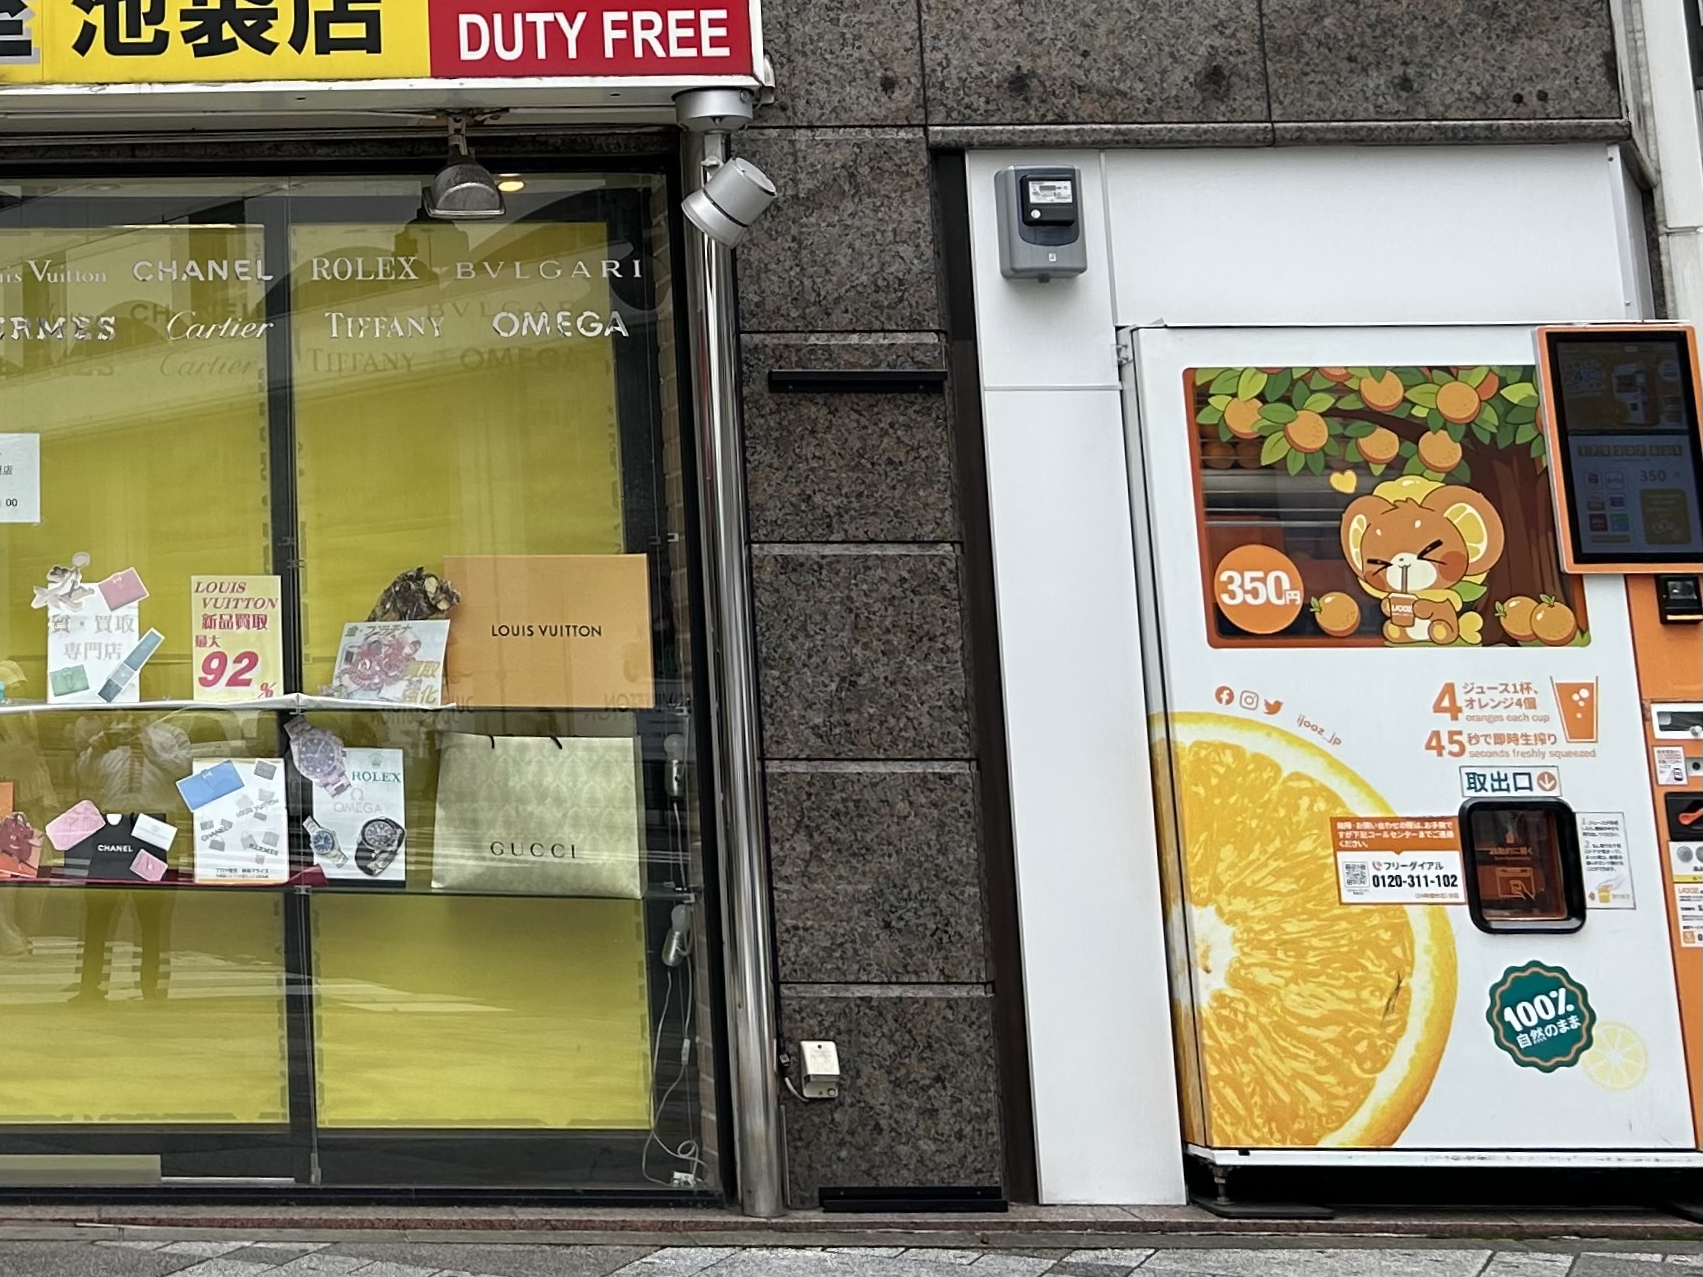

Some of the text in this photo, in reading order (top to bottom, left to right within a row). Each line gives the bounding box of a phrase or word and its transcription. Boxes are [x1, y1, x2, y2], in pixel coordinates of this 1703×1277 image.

[458, 9, 730, 61] DUTY FREE
[28, 259, 107, 283] Vuitton
[132, 259, 274, 281] CHANEL
[311, 256, 419, 281] ROLEX
[455, 259, 642, 280] BVLGARI
[166, 310, 275, 341] Cartier
[325, 312, 444, 339] TIFFANY
[492, 310, 630, 338] OMEGA
[193, 580, 247, 594] LOUIS
[201, 596, 279, 611] VUITTON
[201, 612, 269, 632] 新品買取
[491, 624, 602, 638] LOUIS VUITTON
[1432, 681, 1463, 721] 4
[1464, 696, 1538, 711] オレンジ4個
[1465, 713, 1550, 724] oranges each cup
[1424, 729, 1467, 759] 45
[1469, 748, 1597, 760] seconds freshly squeezed
[351, 770, 402, 784] ROLEX
[1464, 770, 1534, 793] 取出口
[332, 801, 384, 814] OMEGA
[98, 844, 133, 853] CHANEL
[489, 840, 577, 859] GUCCI
[1372, 874, 1458, 888] 0120-311-102
[1503, 987, 1575, 1032] 100%
[1516, 1014, 1582, 1049] 自然のまま
